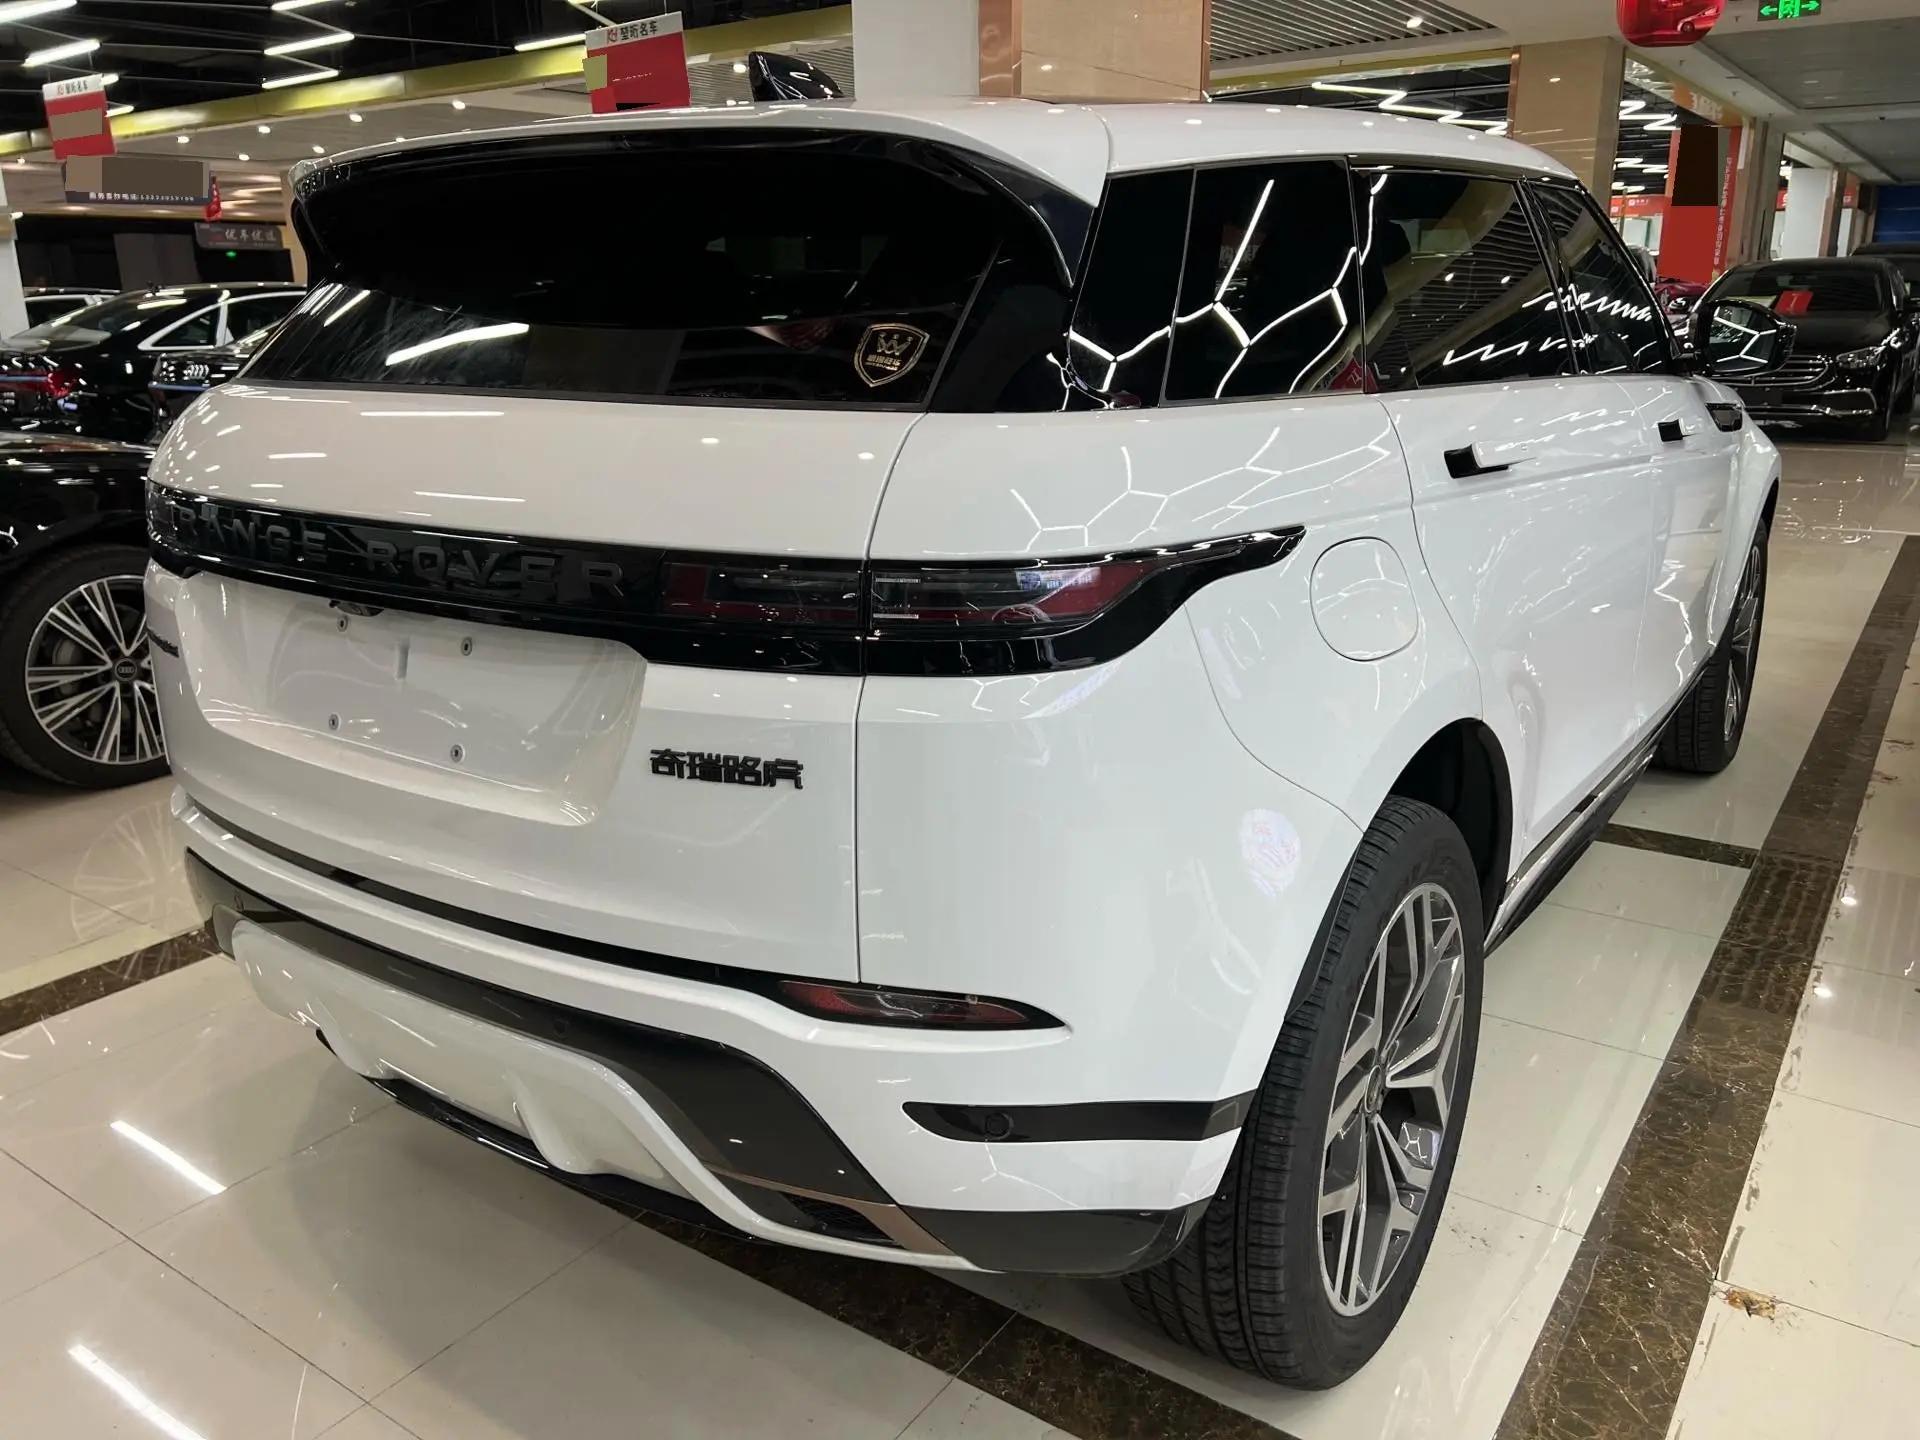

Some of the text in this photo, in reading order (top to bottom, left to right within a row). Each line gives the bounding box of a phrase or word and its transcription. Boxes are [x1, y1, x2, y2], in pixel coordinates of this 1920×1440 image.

[178, 505, 624, 599] RANGE ROVER
[650, 748, 803, 789] 奇瑞路虎
